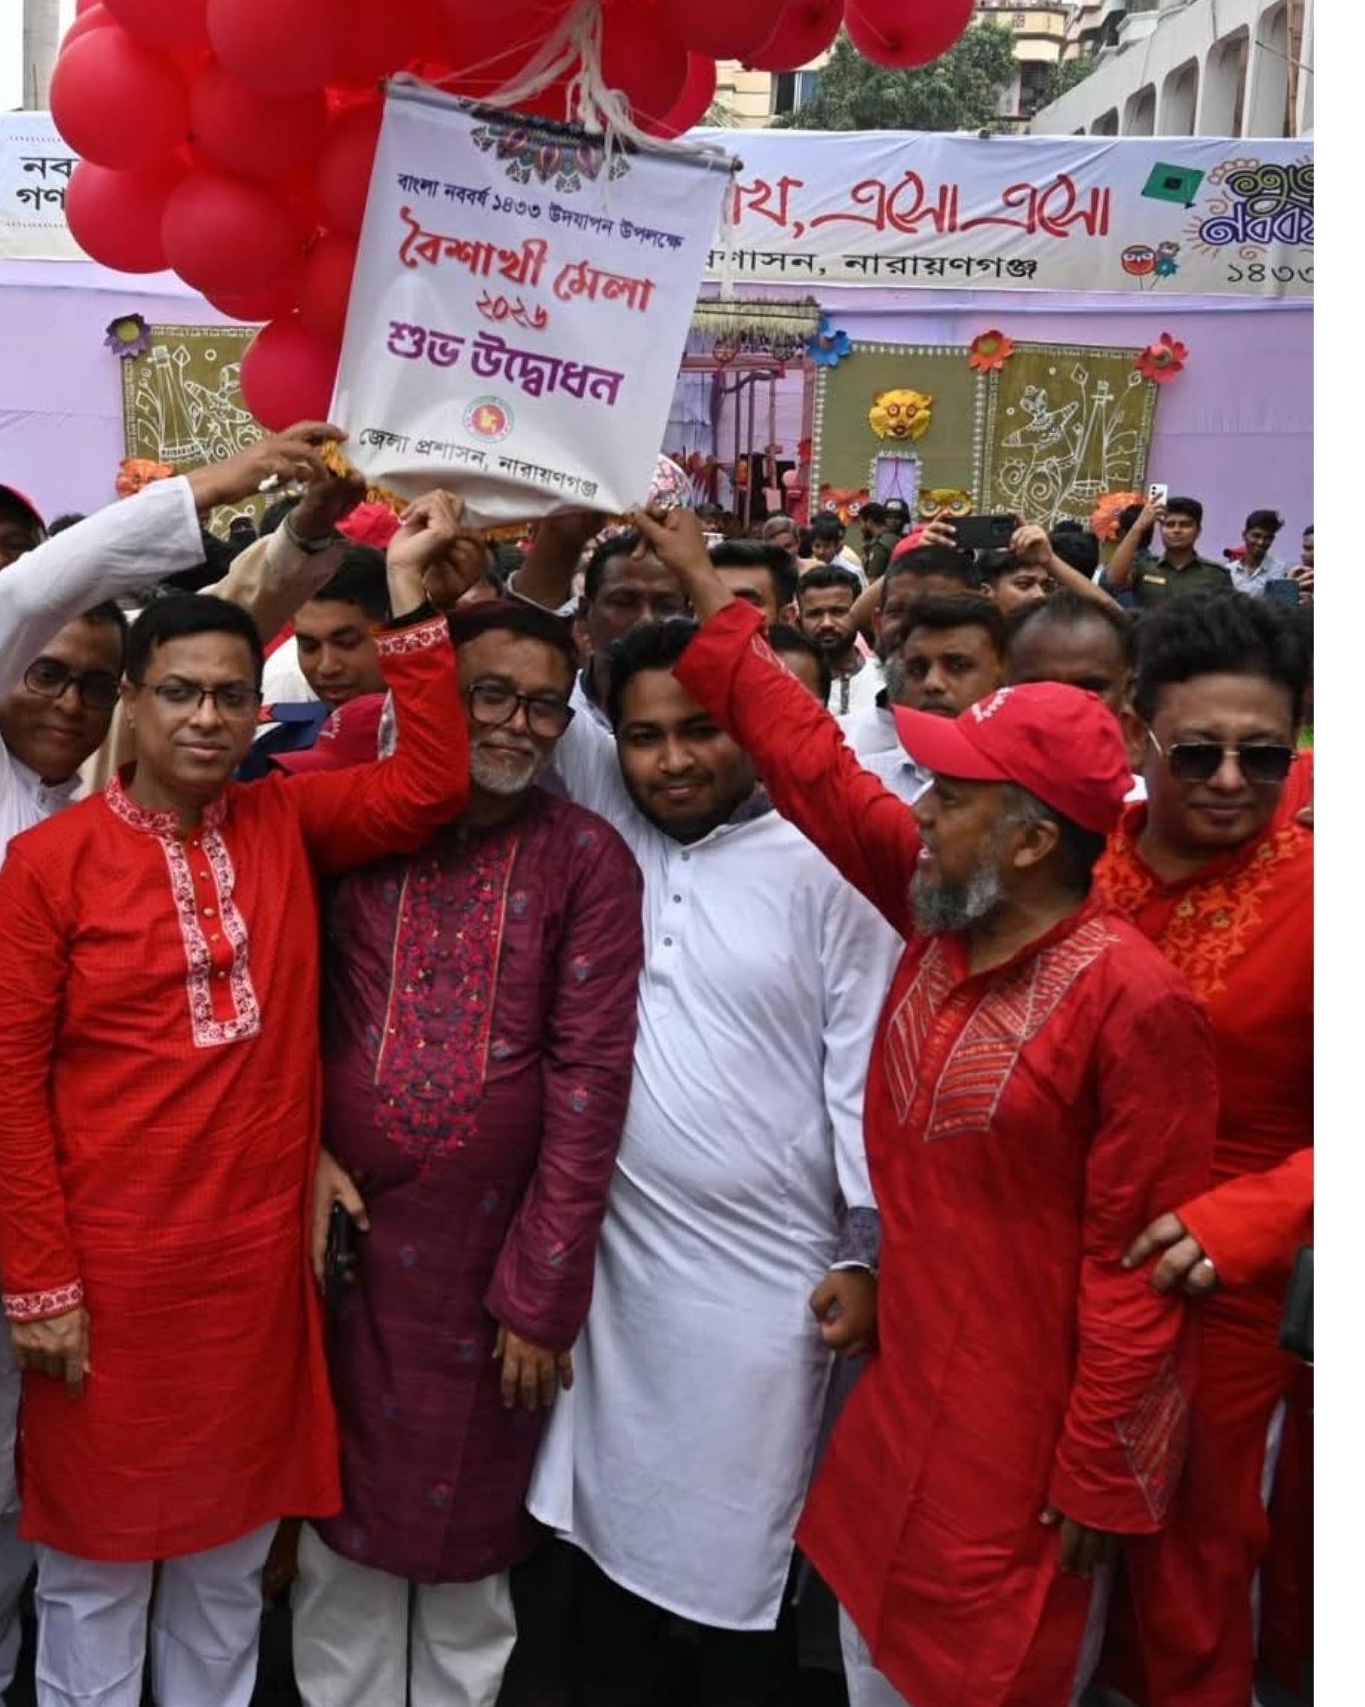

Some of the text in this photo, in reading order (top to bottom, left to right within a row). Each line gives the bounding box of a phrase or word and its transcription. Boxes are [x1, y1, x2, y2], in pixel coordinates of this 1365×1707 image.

[15, 185, 66, 211] গণ
[19, 156, 81, 180] নব
[396, 171, 686, 252] বাংলা নববর্ষ ১৪৩৩ উদযাপন উপলক্ষে
[732, 175, 806, 240] াখ,
[397, 204, 657, 314] বৈশাখী মেলা
[842, 250, 1040, 280] নারায়ণগঞ্জ
[474, 289, 550, 333] ২০২৬
[386, 319, 626, 407] শুভ উদ্বোধন
[358, 425, 600, 501] জেলা প্রশাসন, নারায়ণগঞ্জ
